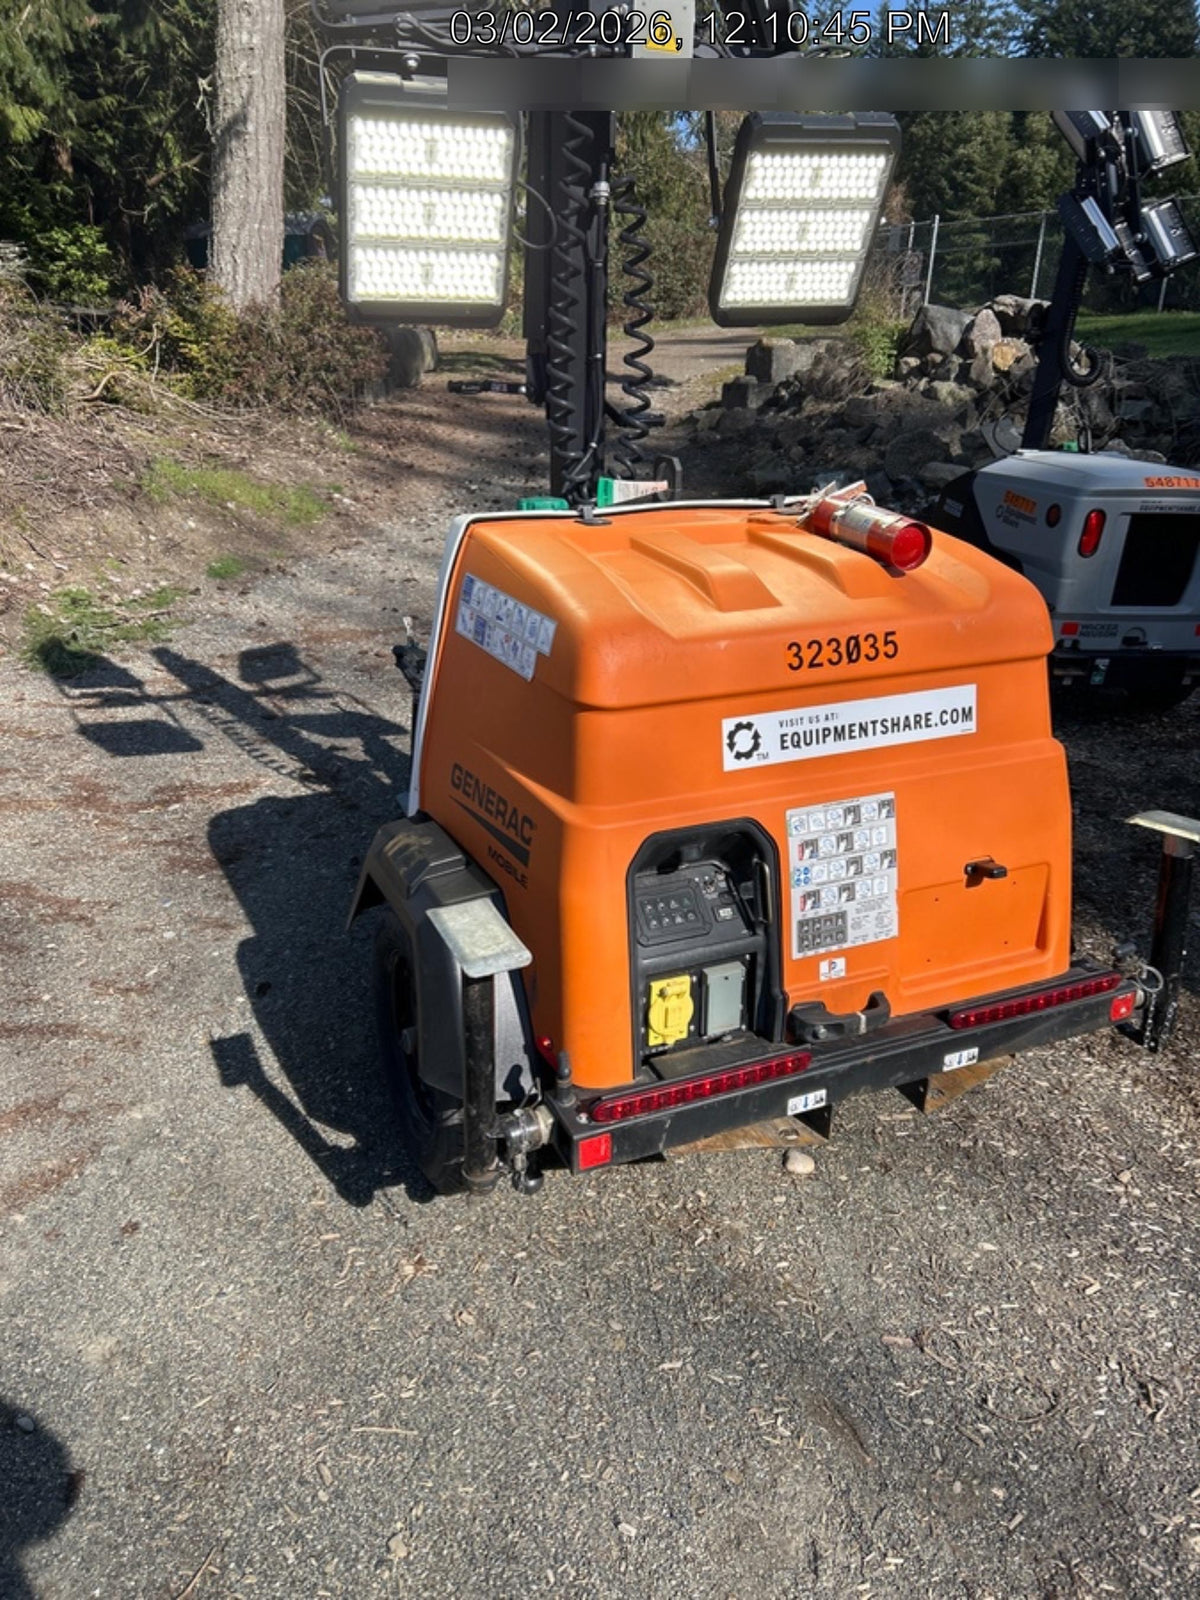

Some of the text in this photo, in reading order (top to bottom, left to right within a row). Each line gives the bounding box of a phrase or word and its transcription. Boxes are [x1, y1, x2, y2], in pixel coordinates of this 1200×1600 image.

[787, 631, 899, 671] 323035
[779, 712, 839, 728] VISIT US AT:
[780, 705, 974, 750] EQUIPMENTSHARE.COM
[756, 751, 769, 761] TM
[450, 762, 535, 846] GENERAC
[487, 845, 528, 890] MOBILE
